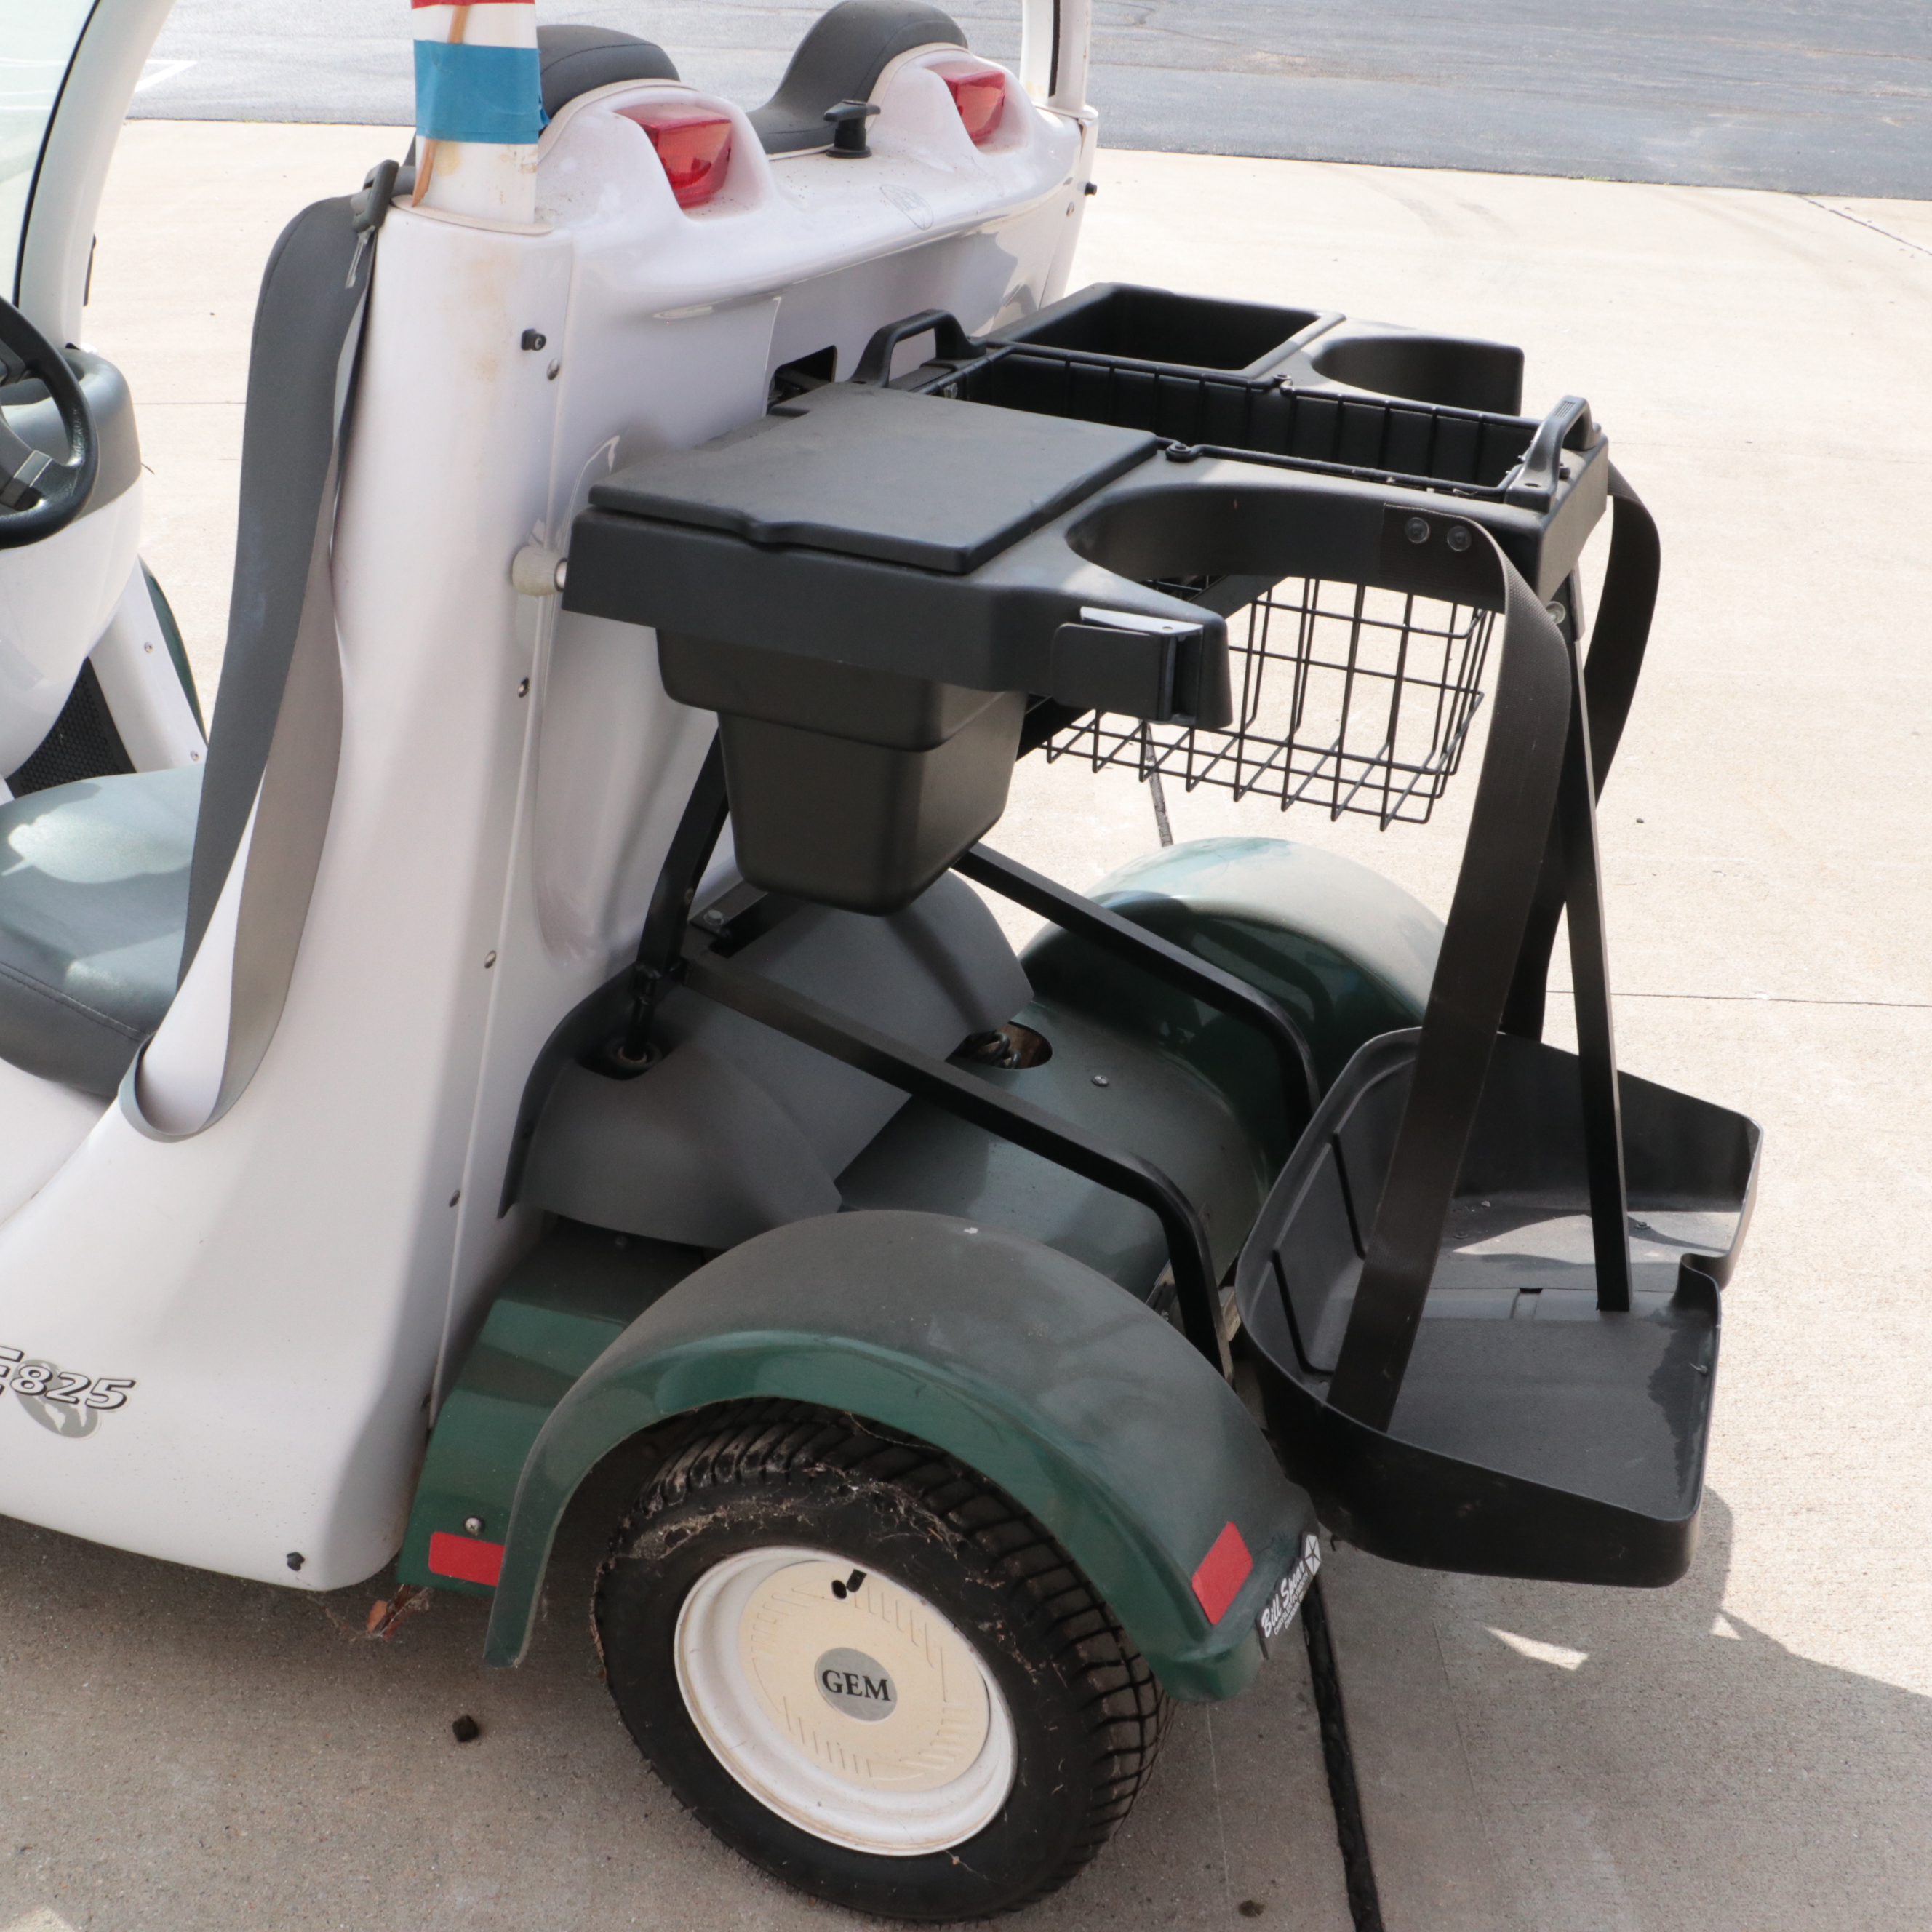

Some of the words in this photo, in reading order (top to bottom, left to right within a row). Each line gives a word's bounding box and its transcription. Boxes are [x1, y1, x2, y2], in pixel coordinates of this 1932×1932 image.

[1261, 1594, 1282, 1638] Bill
[1280, 1560, 1305, 1608] Spear
[822, 1669, 892, 1701] GEM
